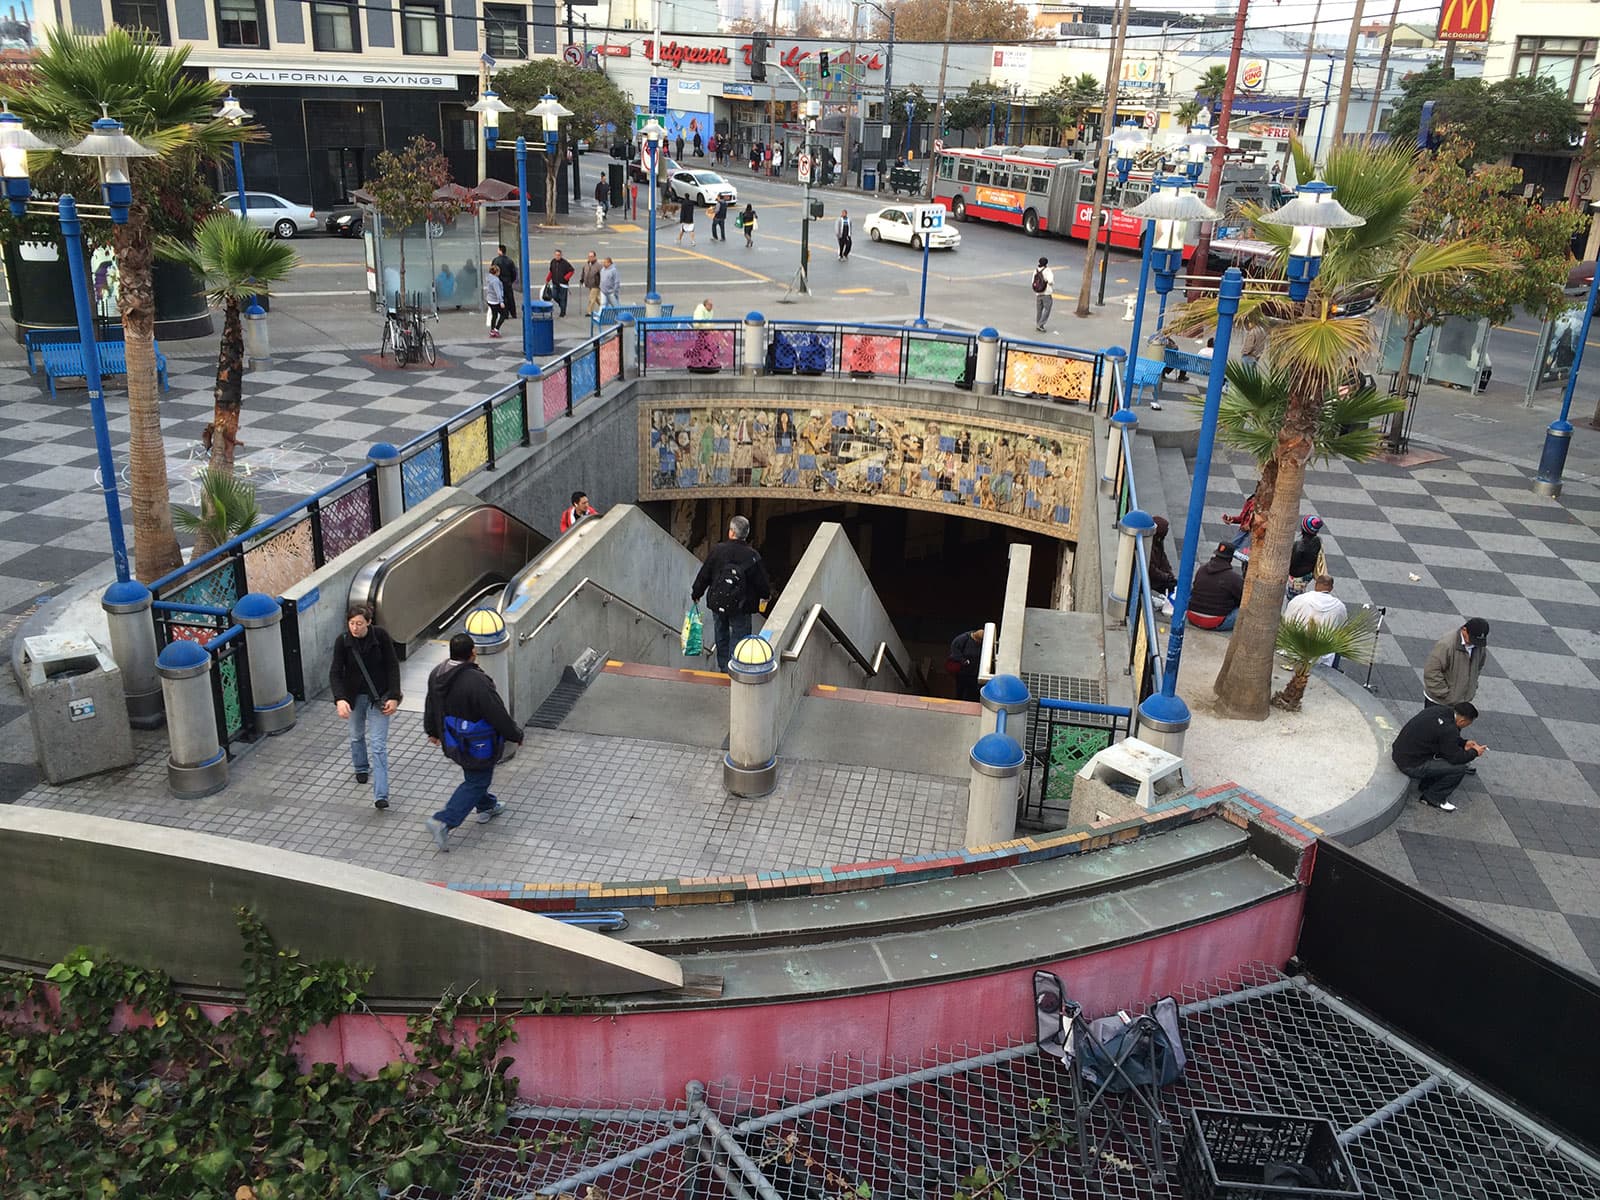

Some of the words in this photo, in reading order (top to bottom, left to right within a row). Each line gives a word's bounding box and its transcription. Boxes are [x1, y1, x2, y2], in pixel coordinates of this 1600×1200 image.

[231, 71, 349, 83] CALIFORNIA
[363, 75, 443, 86] SAVINGS
[1244, 71, 1262, 81] KING
[1267, 127, 1290, 138] FRE
